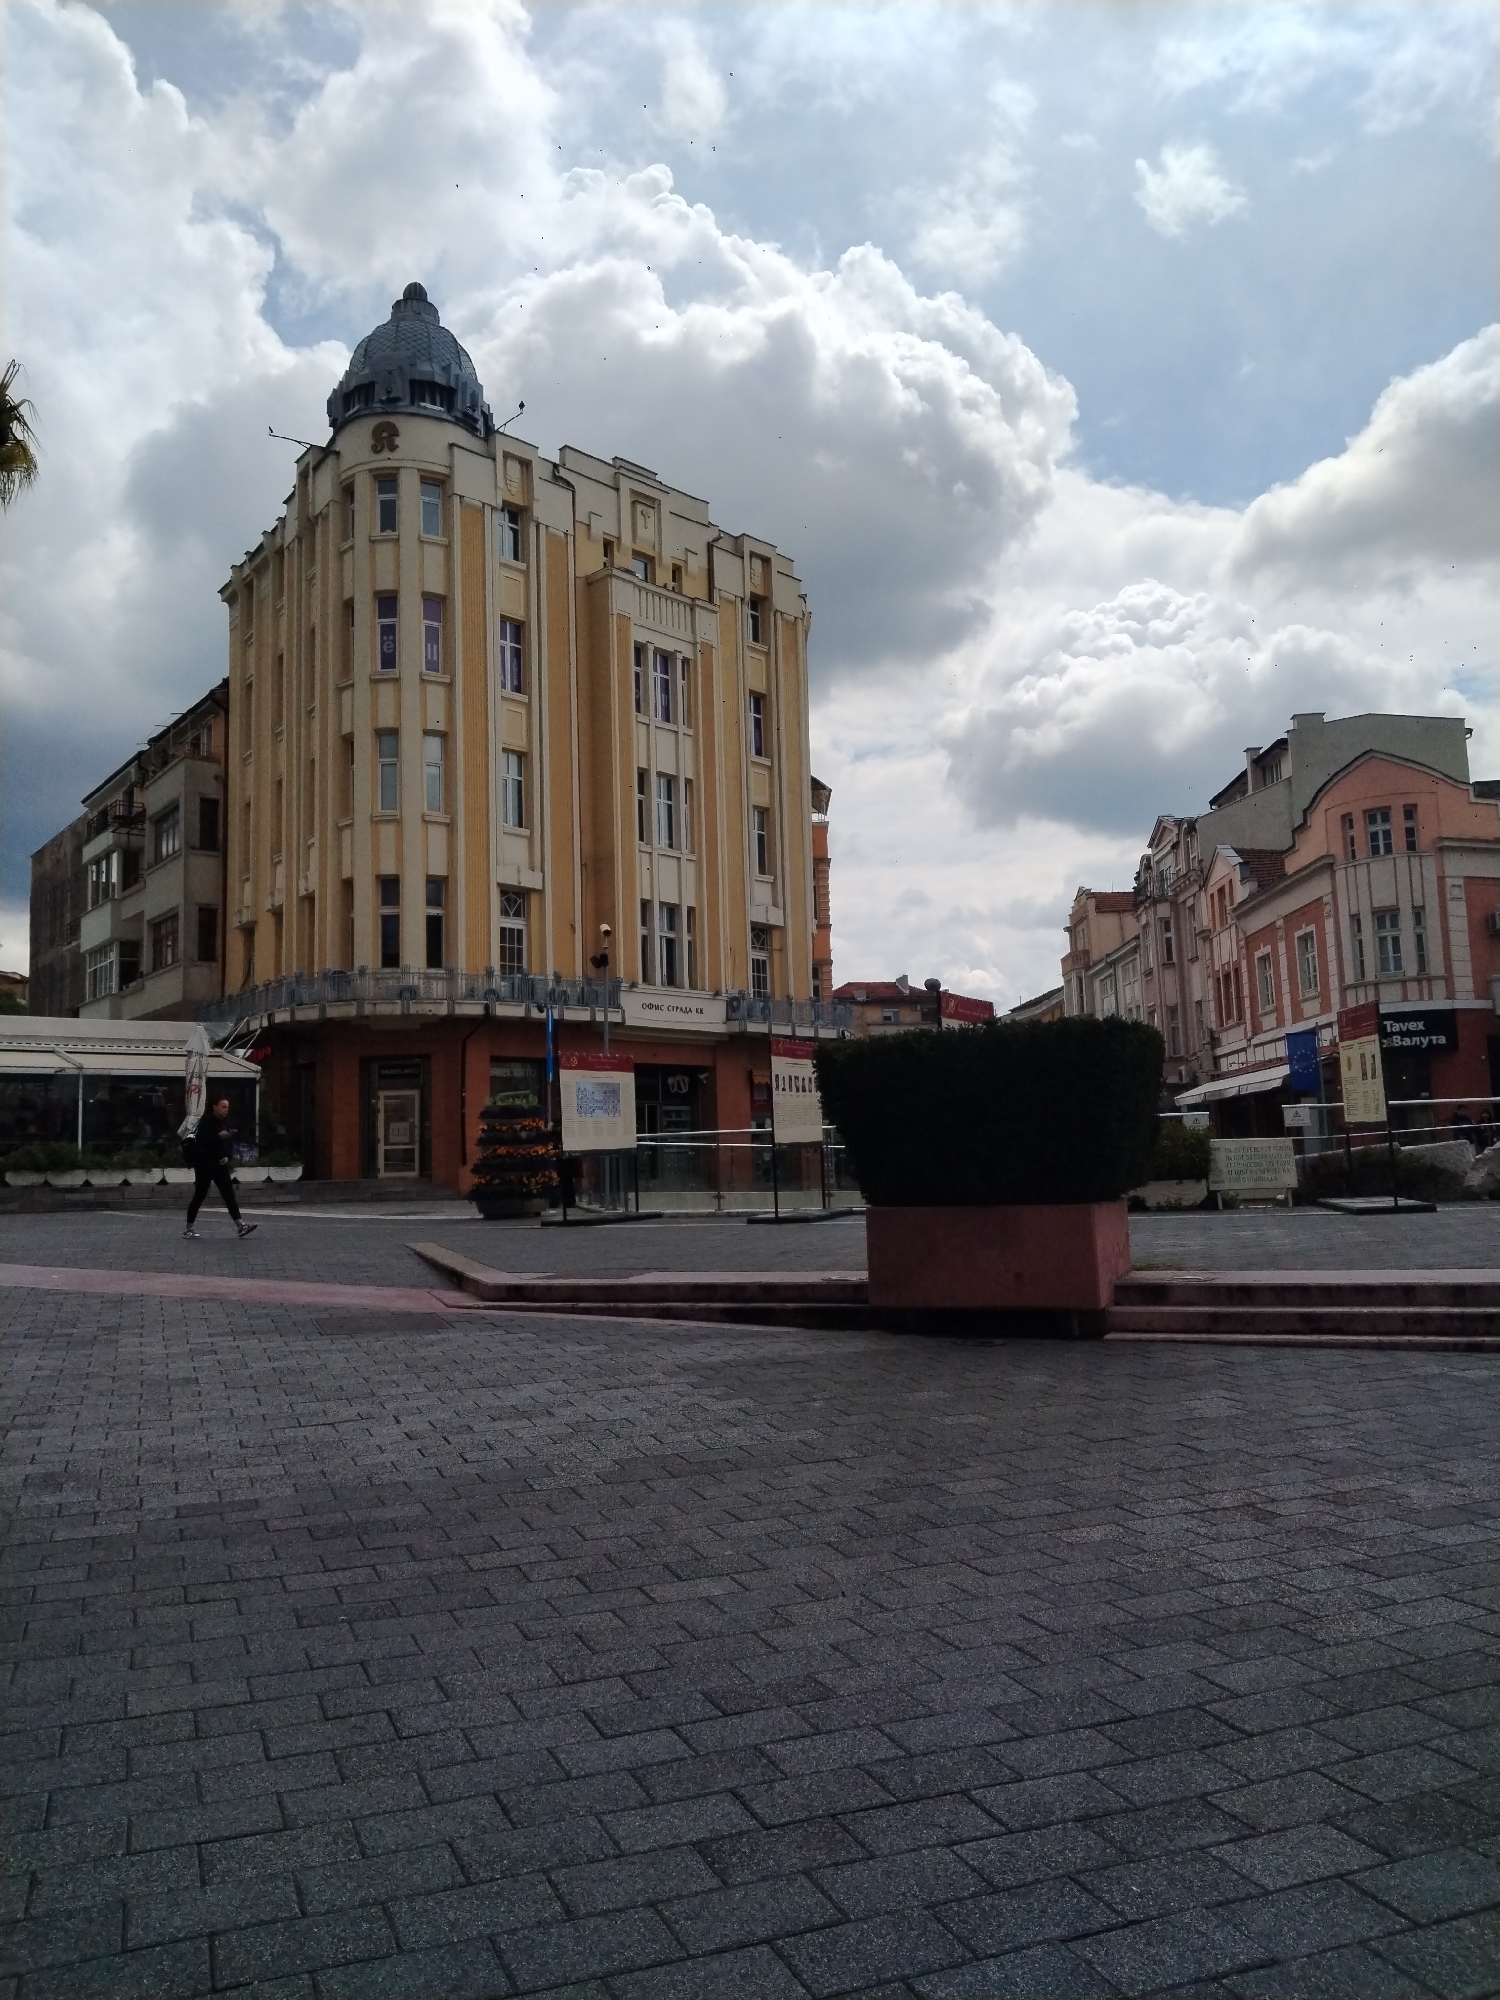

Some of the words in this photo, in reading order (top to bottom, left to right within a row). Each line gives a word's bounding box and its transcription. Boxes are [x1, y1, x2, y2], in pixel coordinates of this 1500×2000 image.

[641, 1002, 665, 1011] ОФИС
[667, 1004, 693, 1015] СТРАДА
[1383, 1020, 1426, 1033] Tavex
[1392, 1035, 1447, 1049] Валута
